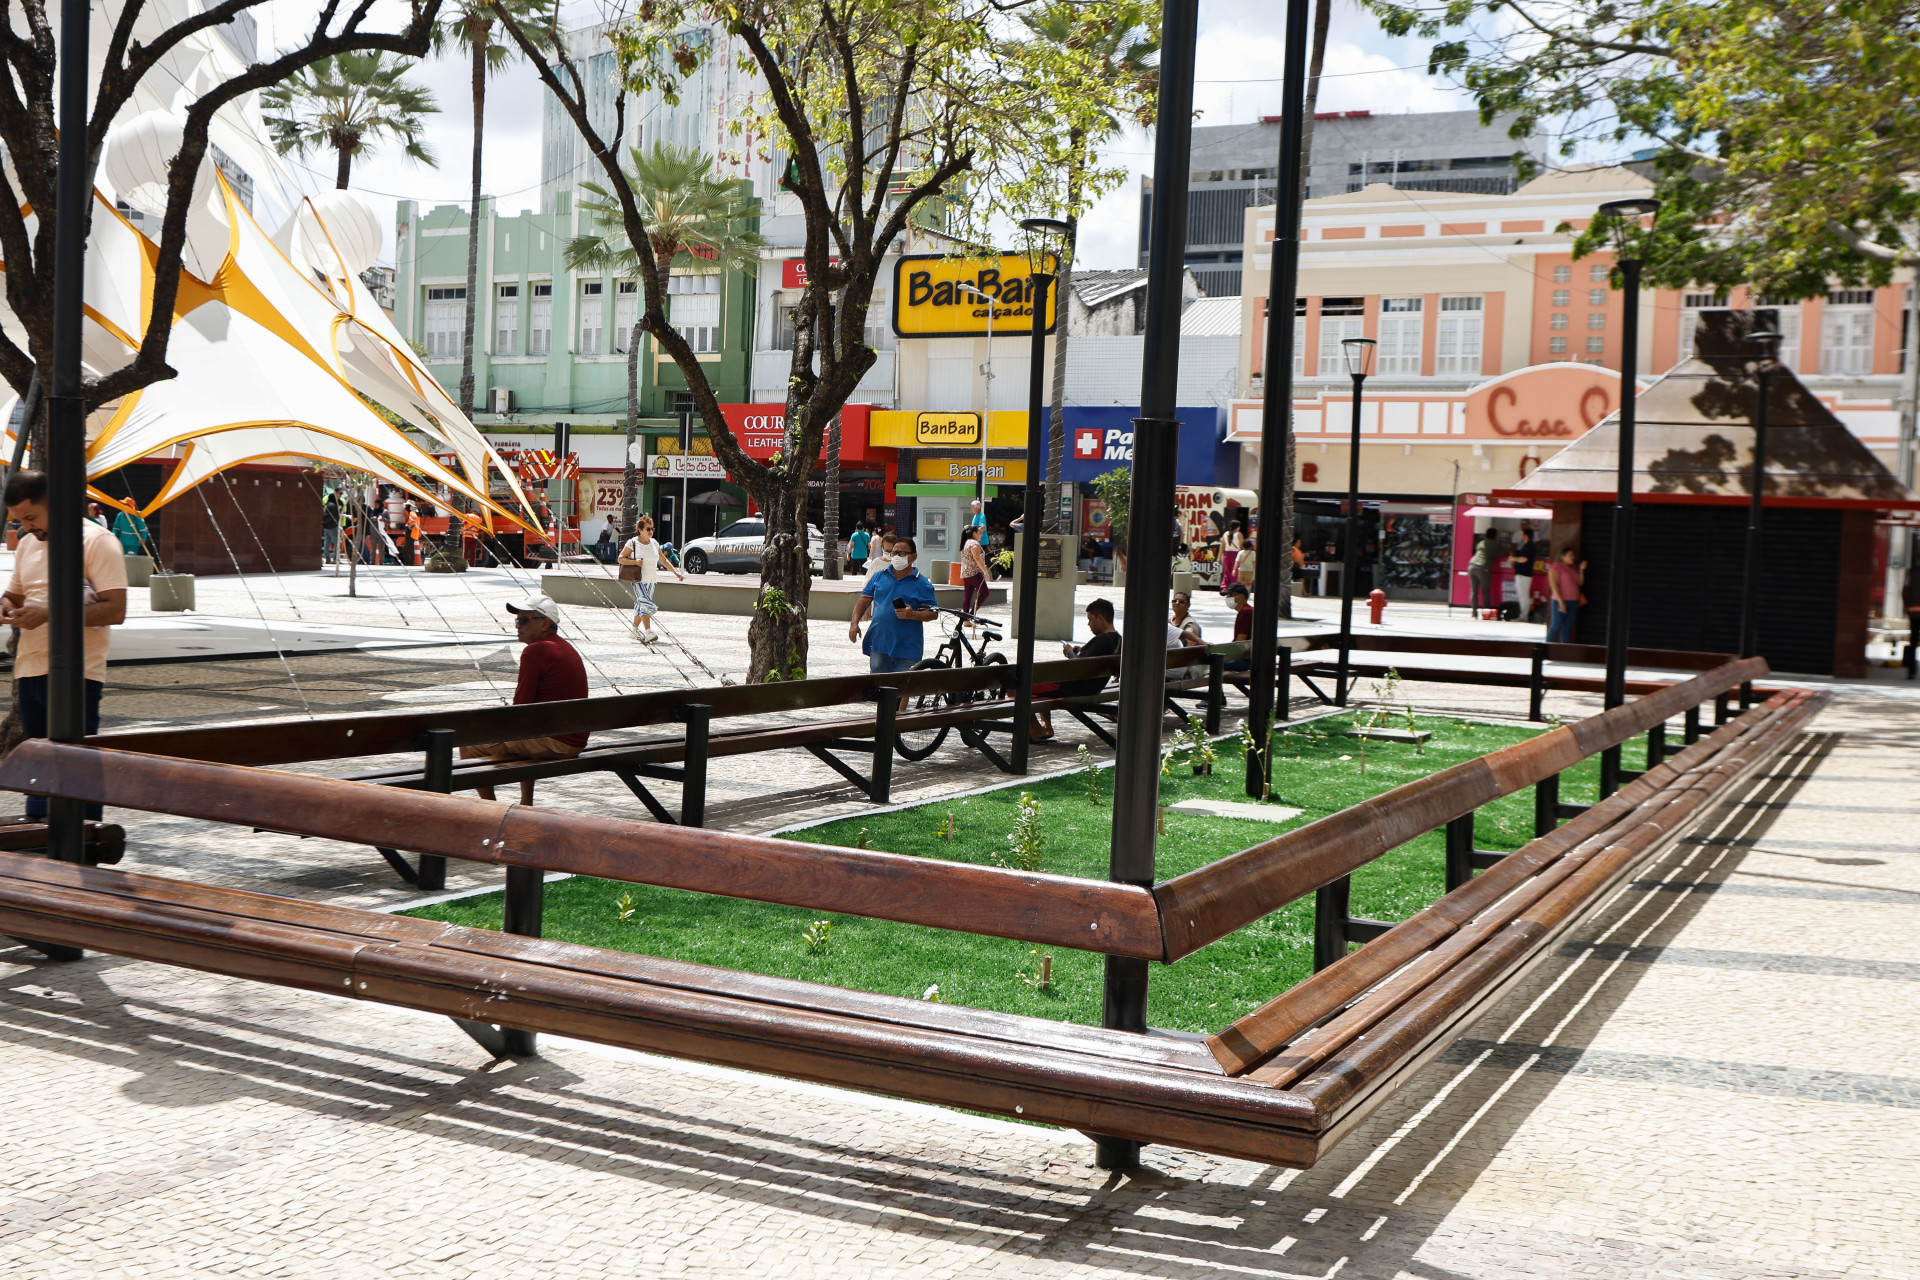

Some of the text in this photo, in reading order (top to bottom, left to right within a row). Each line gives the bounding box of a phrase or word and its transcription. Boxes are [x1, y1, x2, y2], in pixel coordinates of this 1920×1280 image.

[972, 305, 1033, 319] calçado
[1487, 386, 1573, 436] Casa
[744, 415, 785, 430] COUR
[920, 421, 975, 435] BanBan
[748, 438, 783, 448] LEATHE
[1104, 429, 1134, 445] Pa
[1103, 445, 1133, 460] Me
